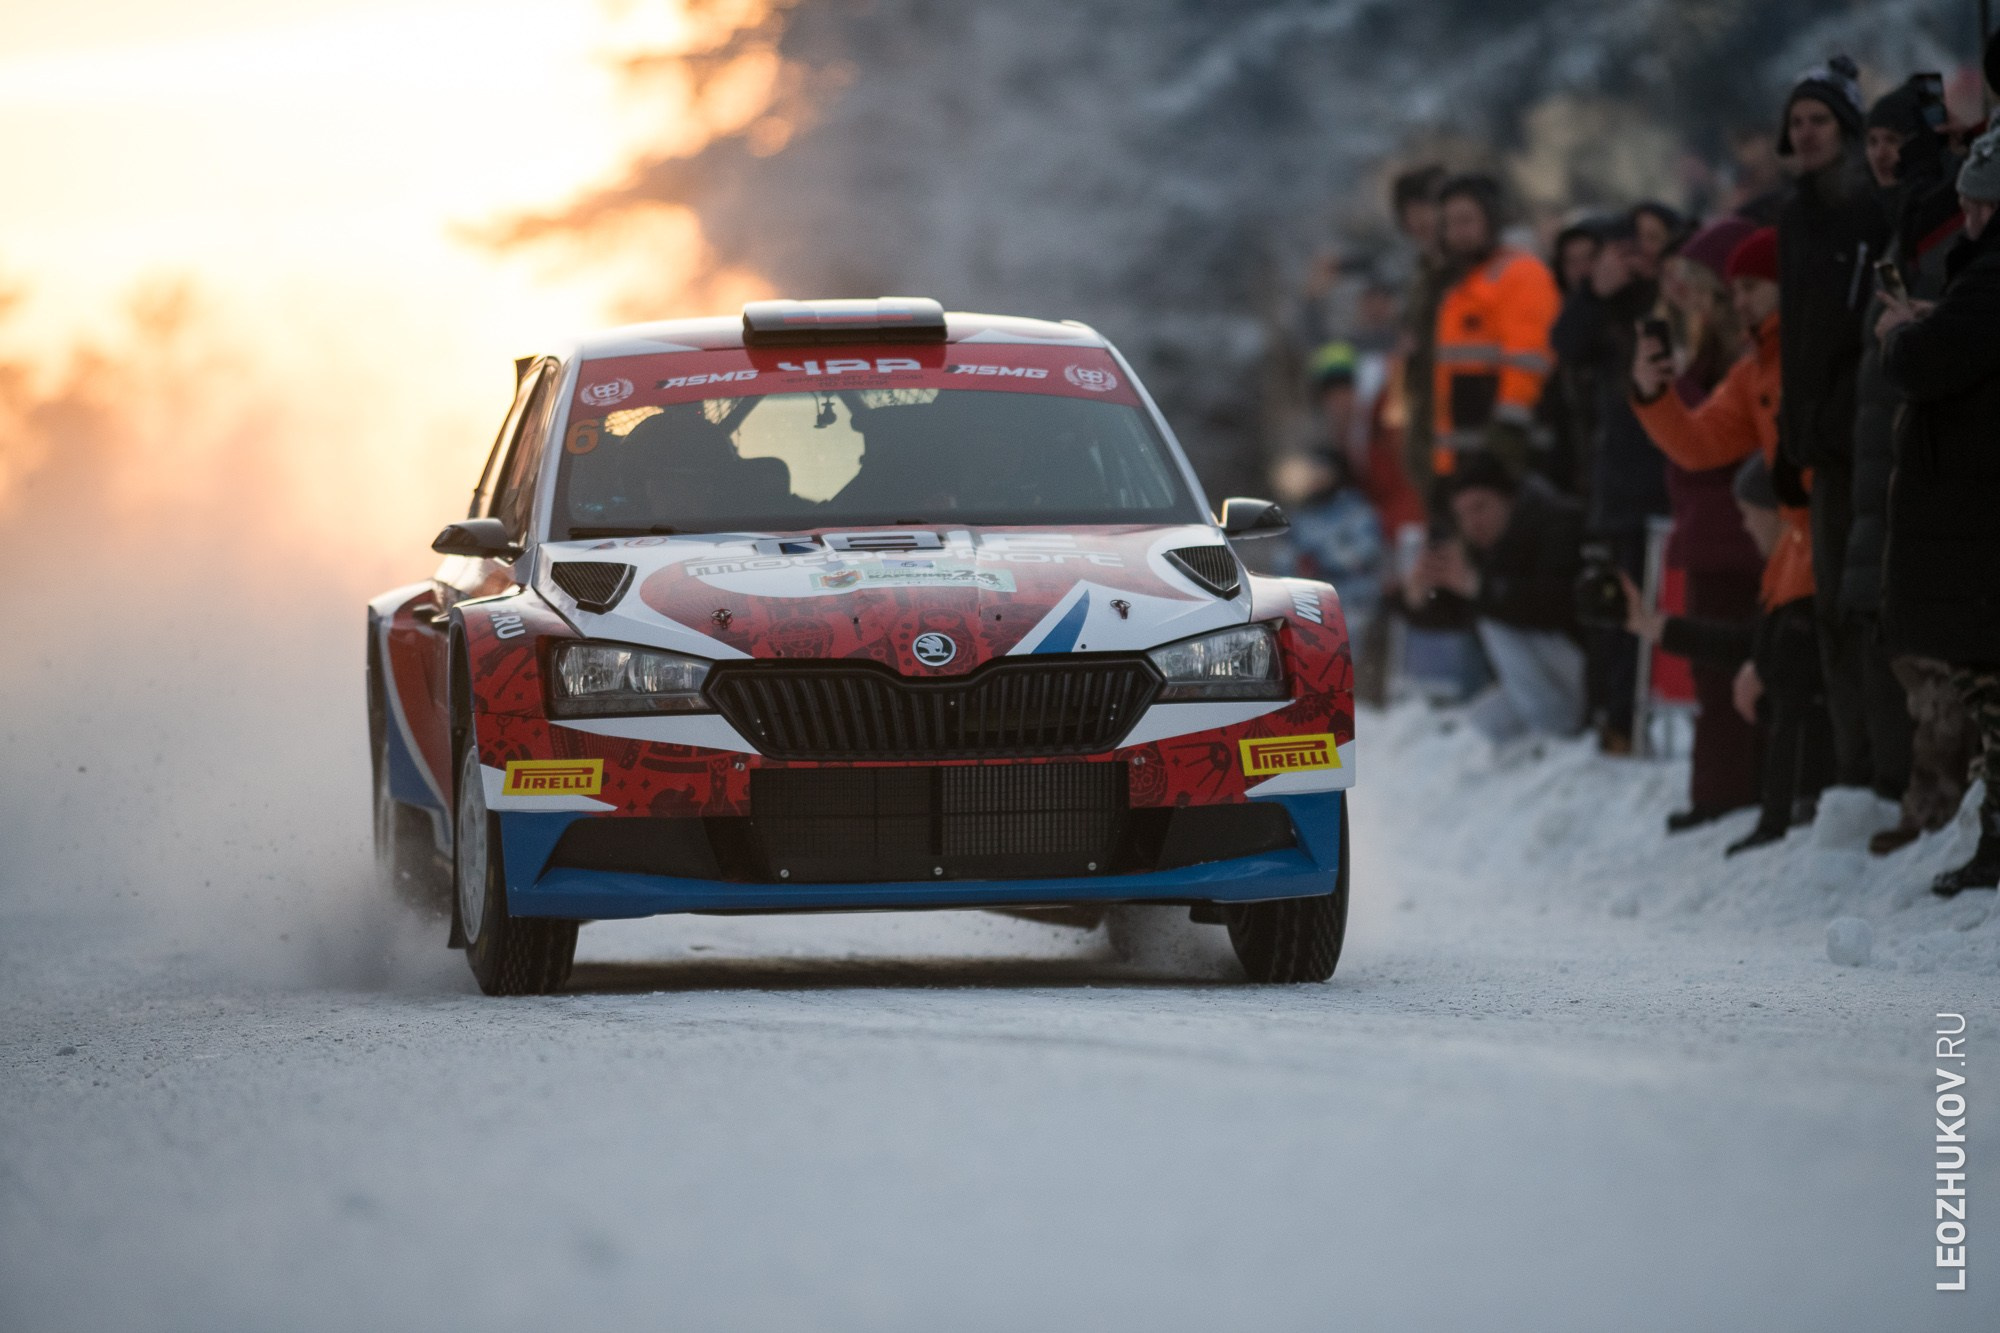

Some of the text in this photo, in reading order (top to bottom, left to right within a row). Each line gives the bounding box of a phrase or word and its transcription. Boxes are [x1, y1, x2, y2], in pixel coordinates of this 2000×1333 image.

[566, 419, 599, 455] 6
[1249, 740, 1330, 770] PIRELLI
[511, 767, 594, 789] PIRELLI
